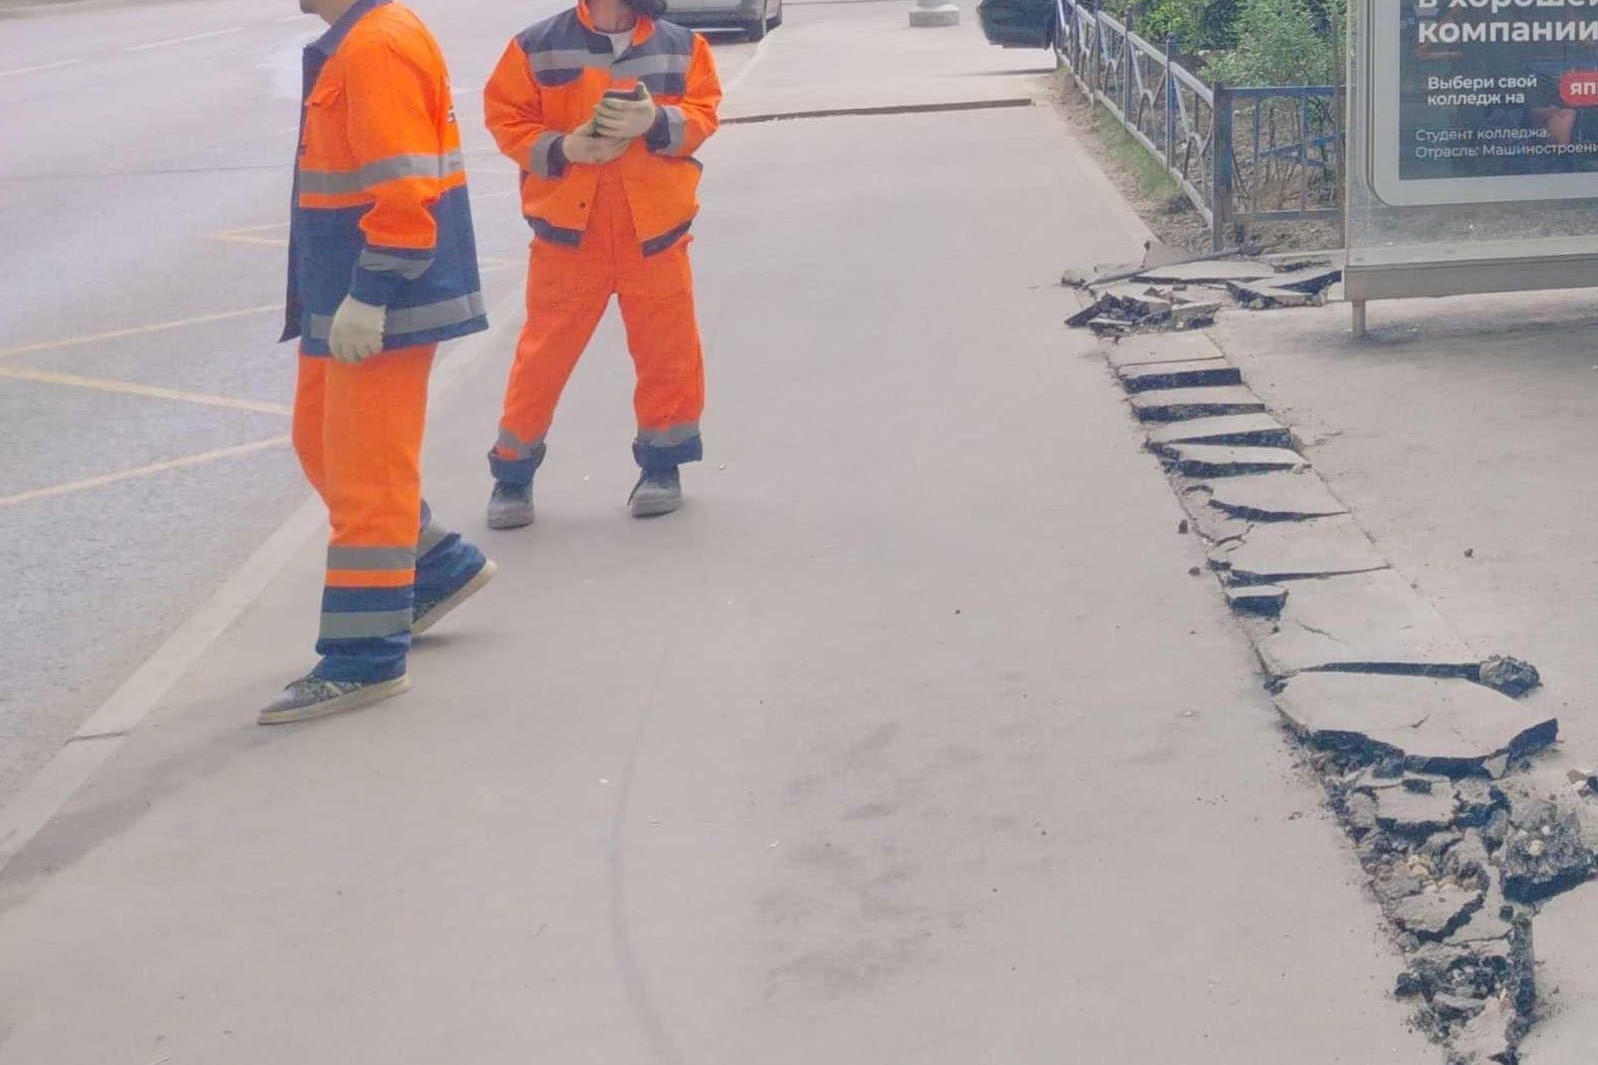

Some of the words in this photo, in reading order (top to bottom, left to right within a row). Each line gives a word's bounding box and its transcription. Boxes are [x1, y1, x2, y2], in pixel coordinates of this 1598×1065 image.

[1427, 75, 1495, 91] Выбери
[1498, 74, 1538, 88] свой
[1427, 93, 1502, 107] колледж
[1505, 93, 1526, 104] на
[1415, 129, 1473, 144] Студент
[1415, 146, 1479, 160] Отрасль:
